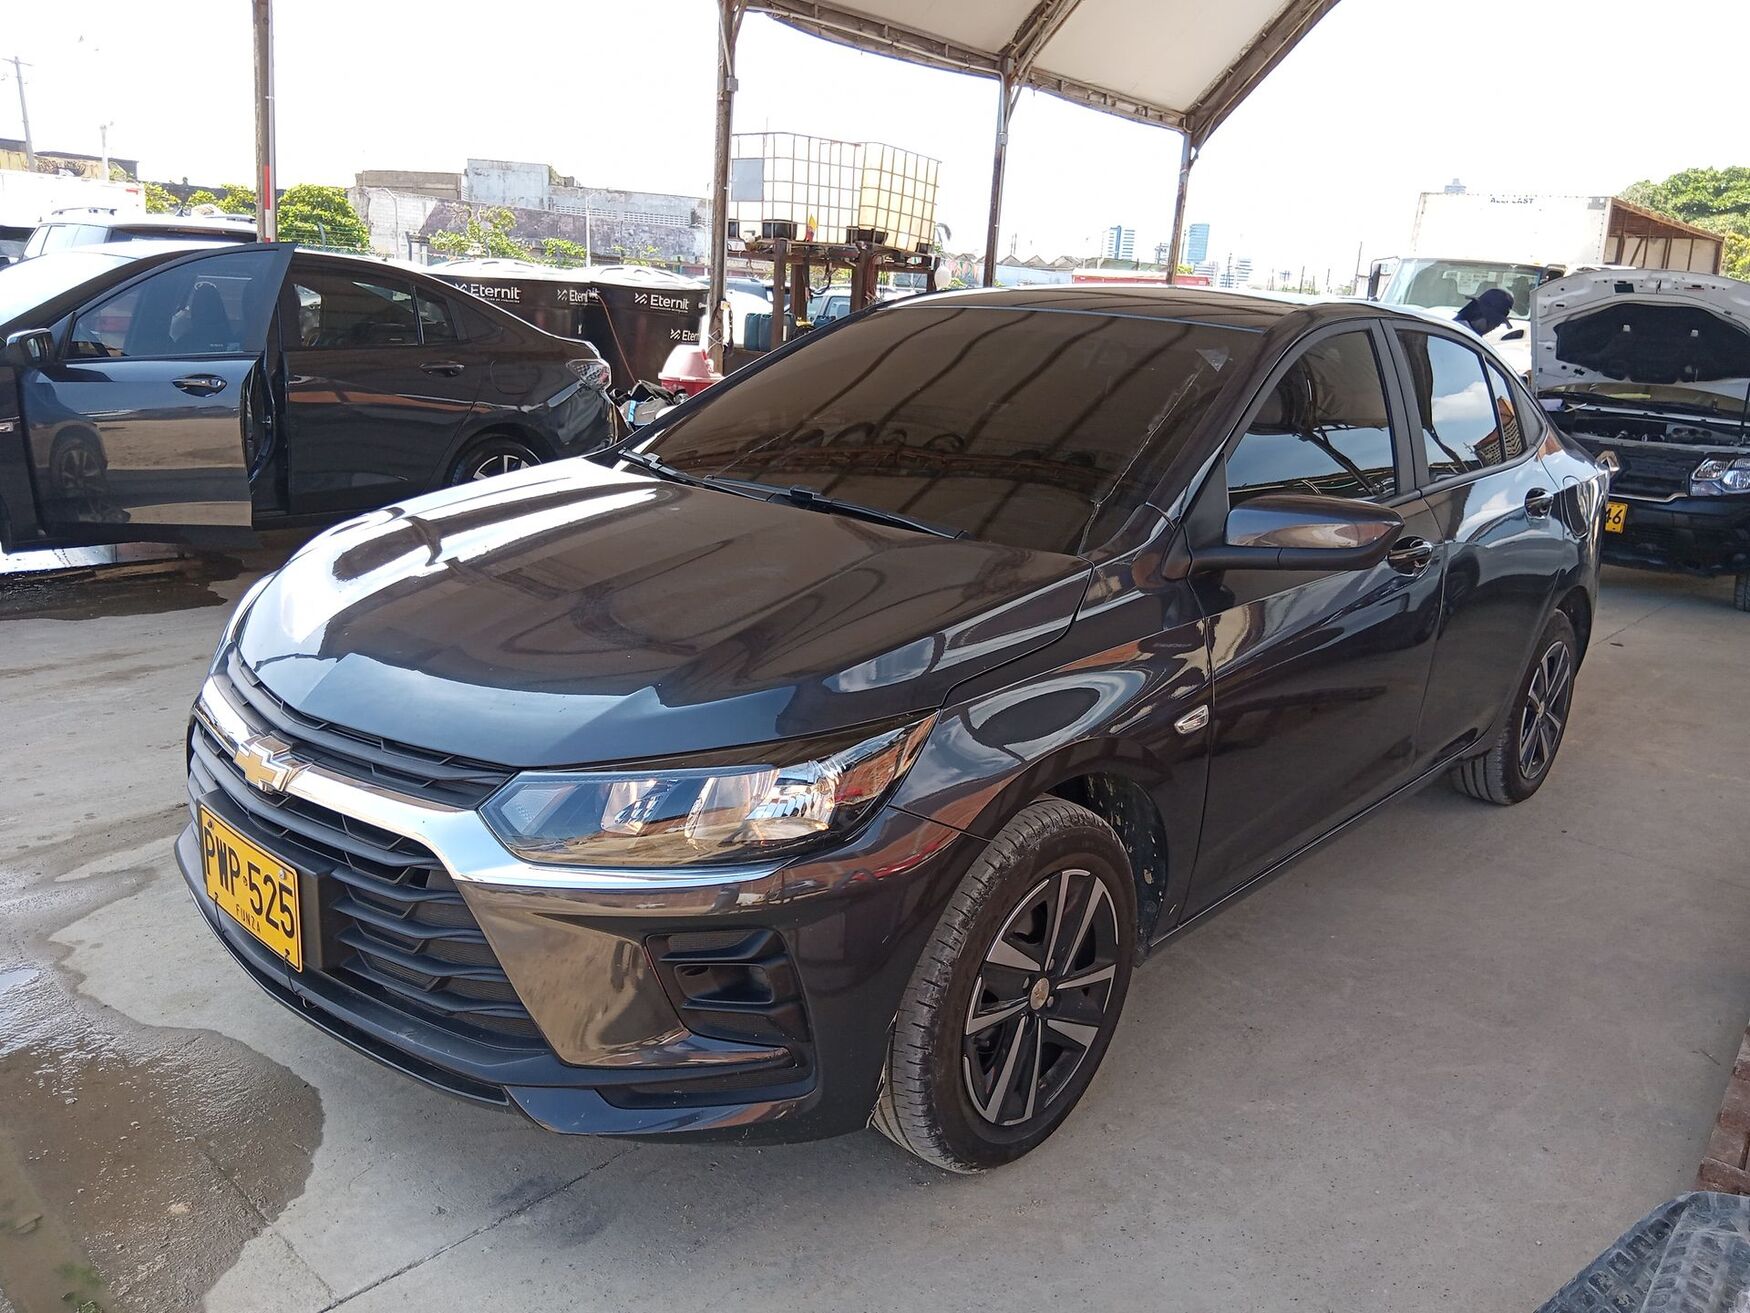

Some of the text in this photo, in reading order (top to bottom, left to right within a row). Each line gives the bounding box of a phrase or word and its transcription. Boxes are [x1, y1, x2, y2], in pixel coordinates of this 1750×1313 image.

[470, 283, 521, 300] Eternit
[650, 294, 689, 310] Eternit
[204, 825, 295, 939] PWP 525
[235, 903, 262, 933] FUNZA
